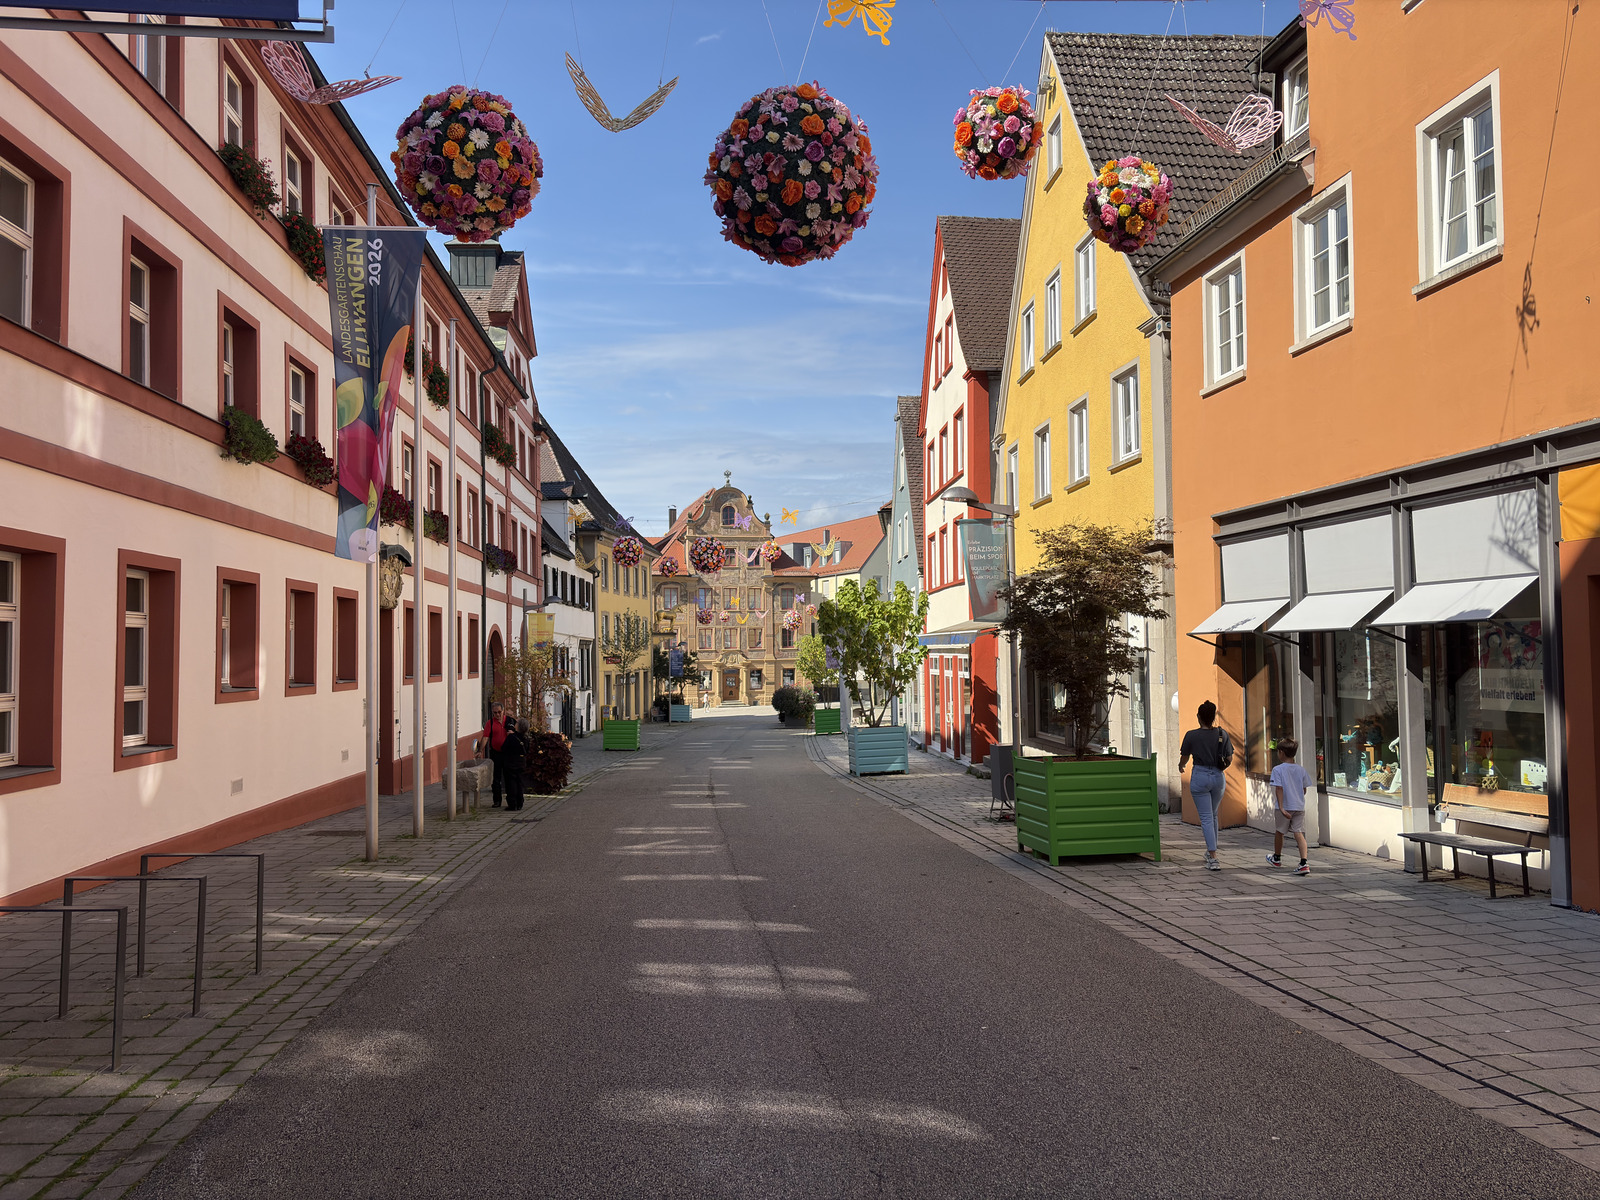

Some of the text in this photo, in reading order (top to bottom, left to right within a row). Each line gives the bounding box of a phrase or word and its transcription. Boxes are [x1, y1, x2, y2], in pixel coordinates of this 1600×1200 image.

[332, 236, 353, 363] LANDESGARTENSCHAU
[346, 238, 370, 368] ELLWANGEN
[367, 238, 383, 287] 2026
[1481, 688, 1536, 701] Vielfalt erleben!
